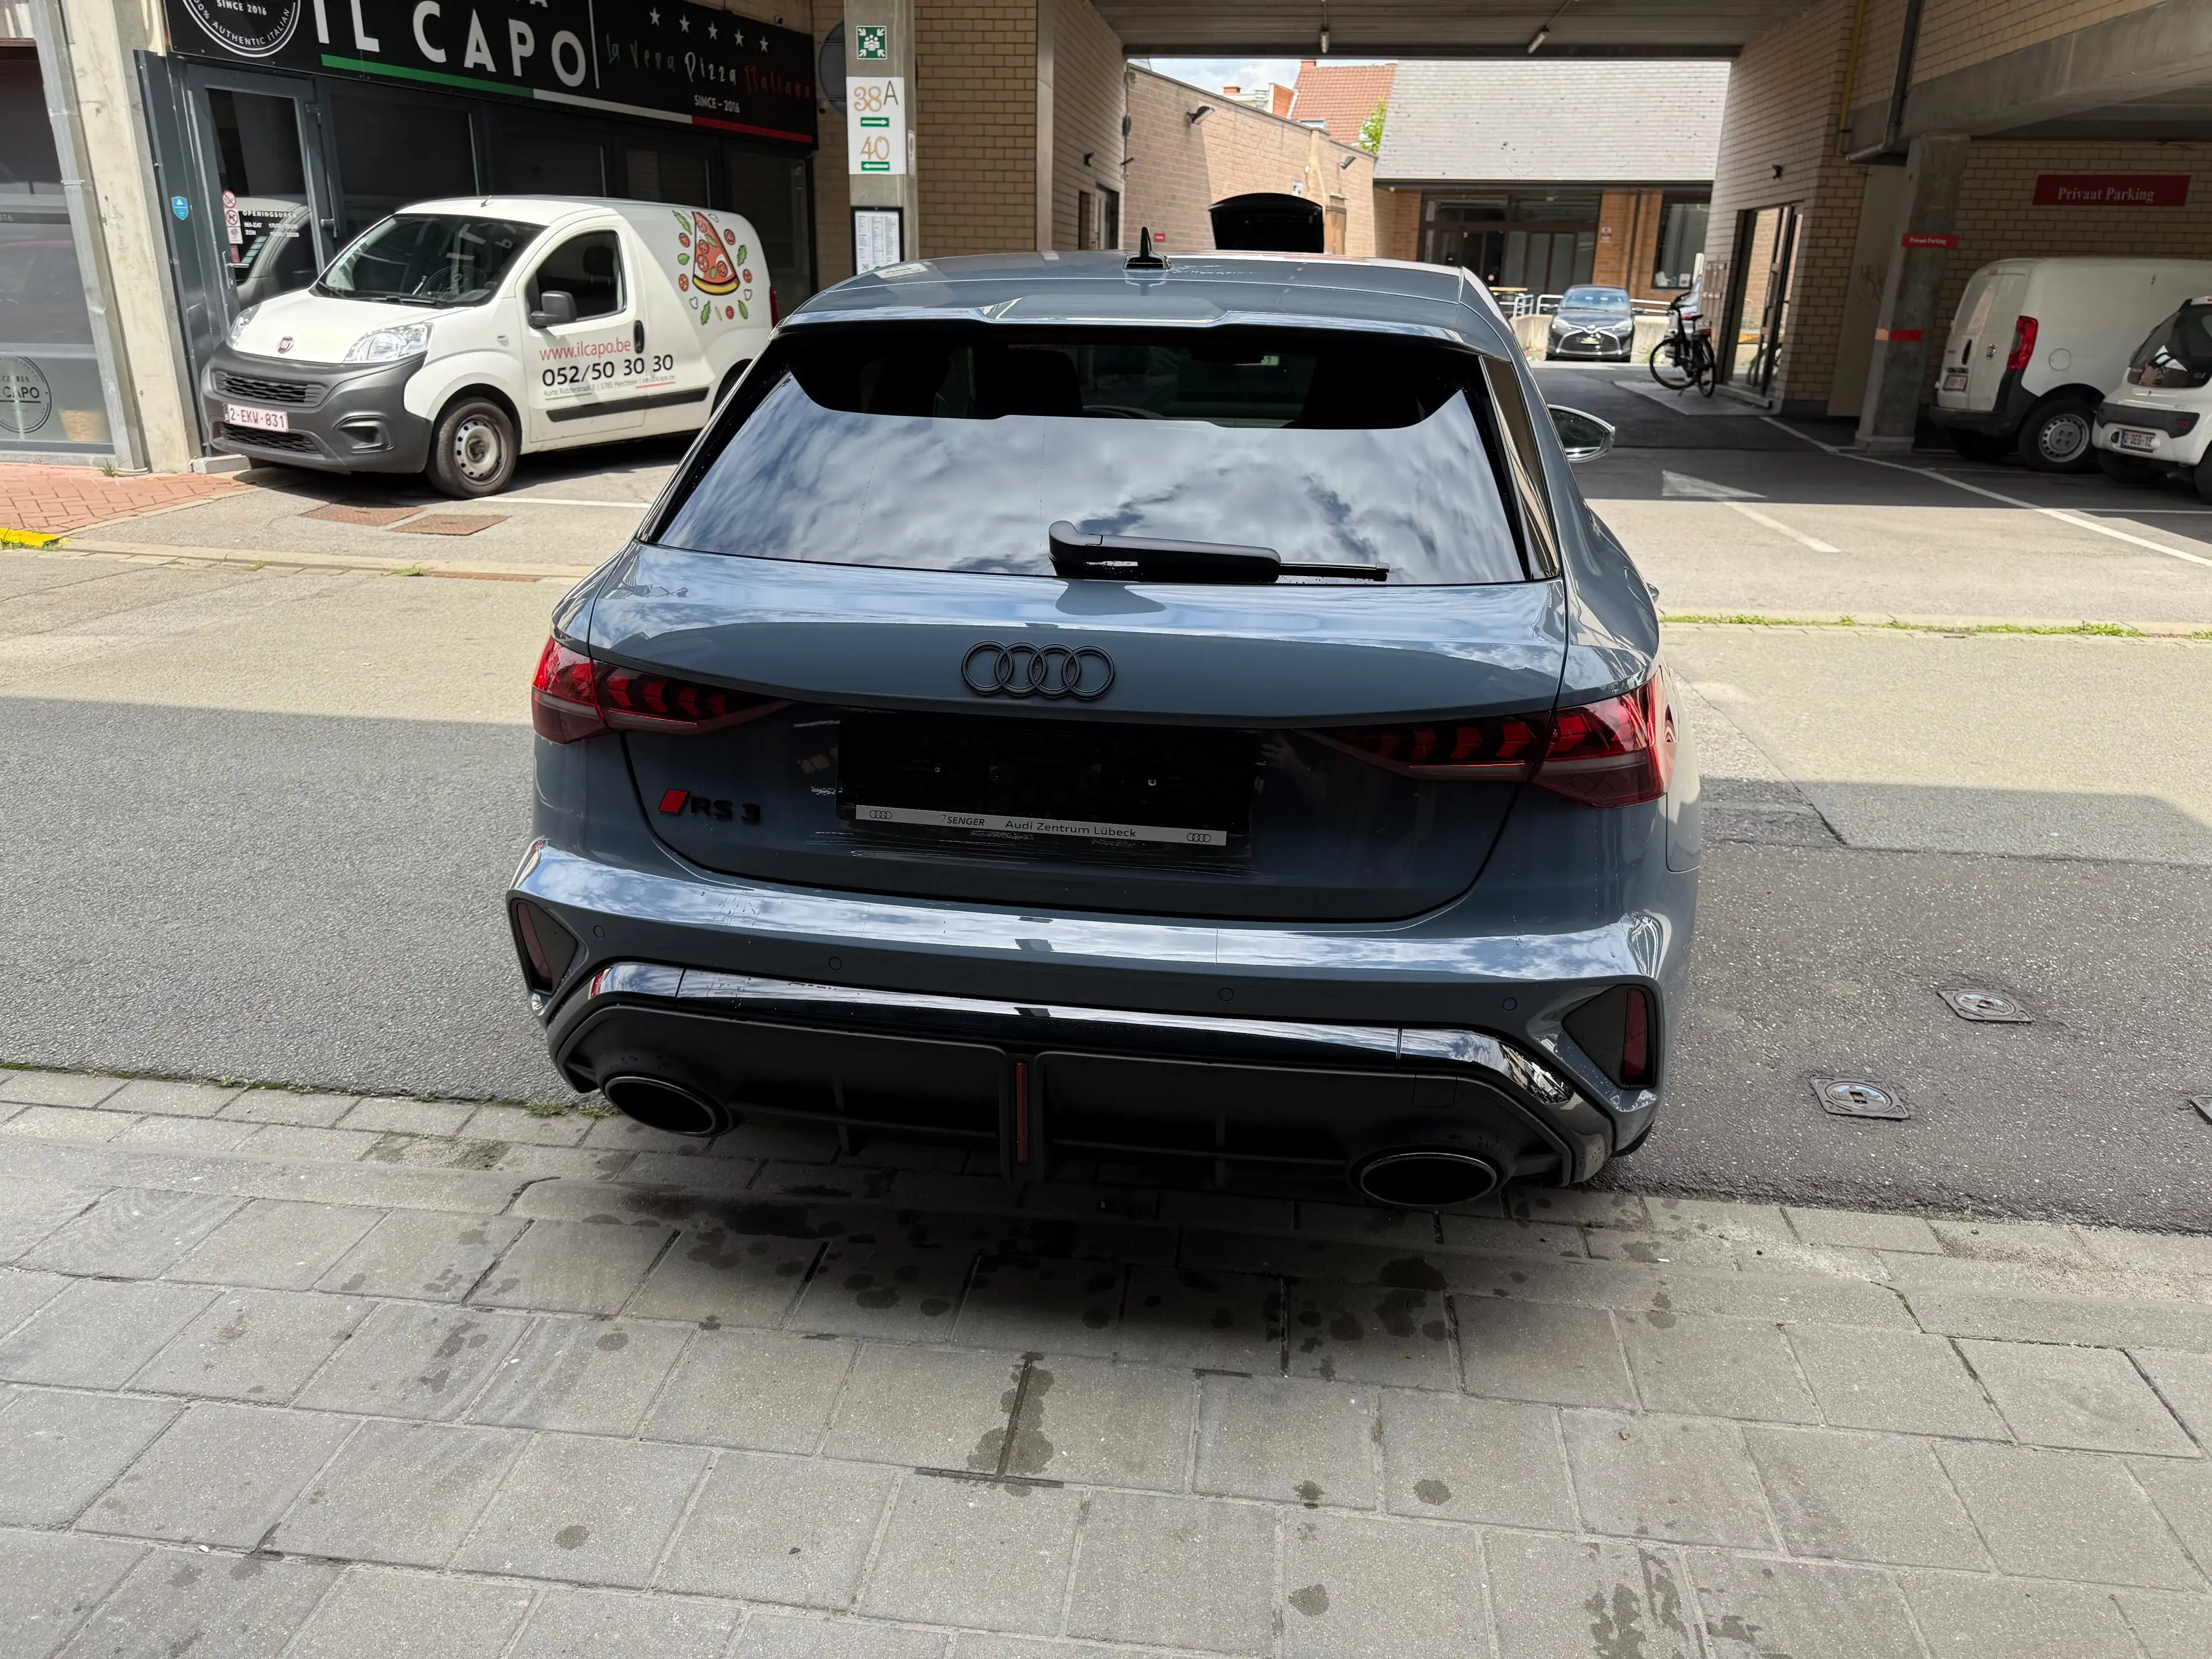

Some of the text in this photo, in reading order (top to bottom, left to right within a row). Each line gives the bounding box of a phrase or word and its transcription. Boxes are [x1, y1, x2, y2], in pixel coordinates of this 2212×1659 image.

[217, 0, 267, 16] SINCE 2016
[193, 0, 290, 46] 0% AUTHENTIC ITALIAN
[313, 0, 586, 88] IL CAPO
[684, 52, 737, 85] Pizza
[694, 94, 717, 109] SINCE
[860, 136, 890, 160] 40
[2058, 187, 2155, 204] Privaat Parking
[0, 214, 14, 222] 16
[540, 337, 632, 361] www.ilcapo.be
[542, 354, 673, 387] 052/50 30 30
[690, 796, 761, 823] RS 3
[947, 816, 1136, 837] SENGER Audi Zentrum Lübeck
